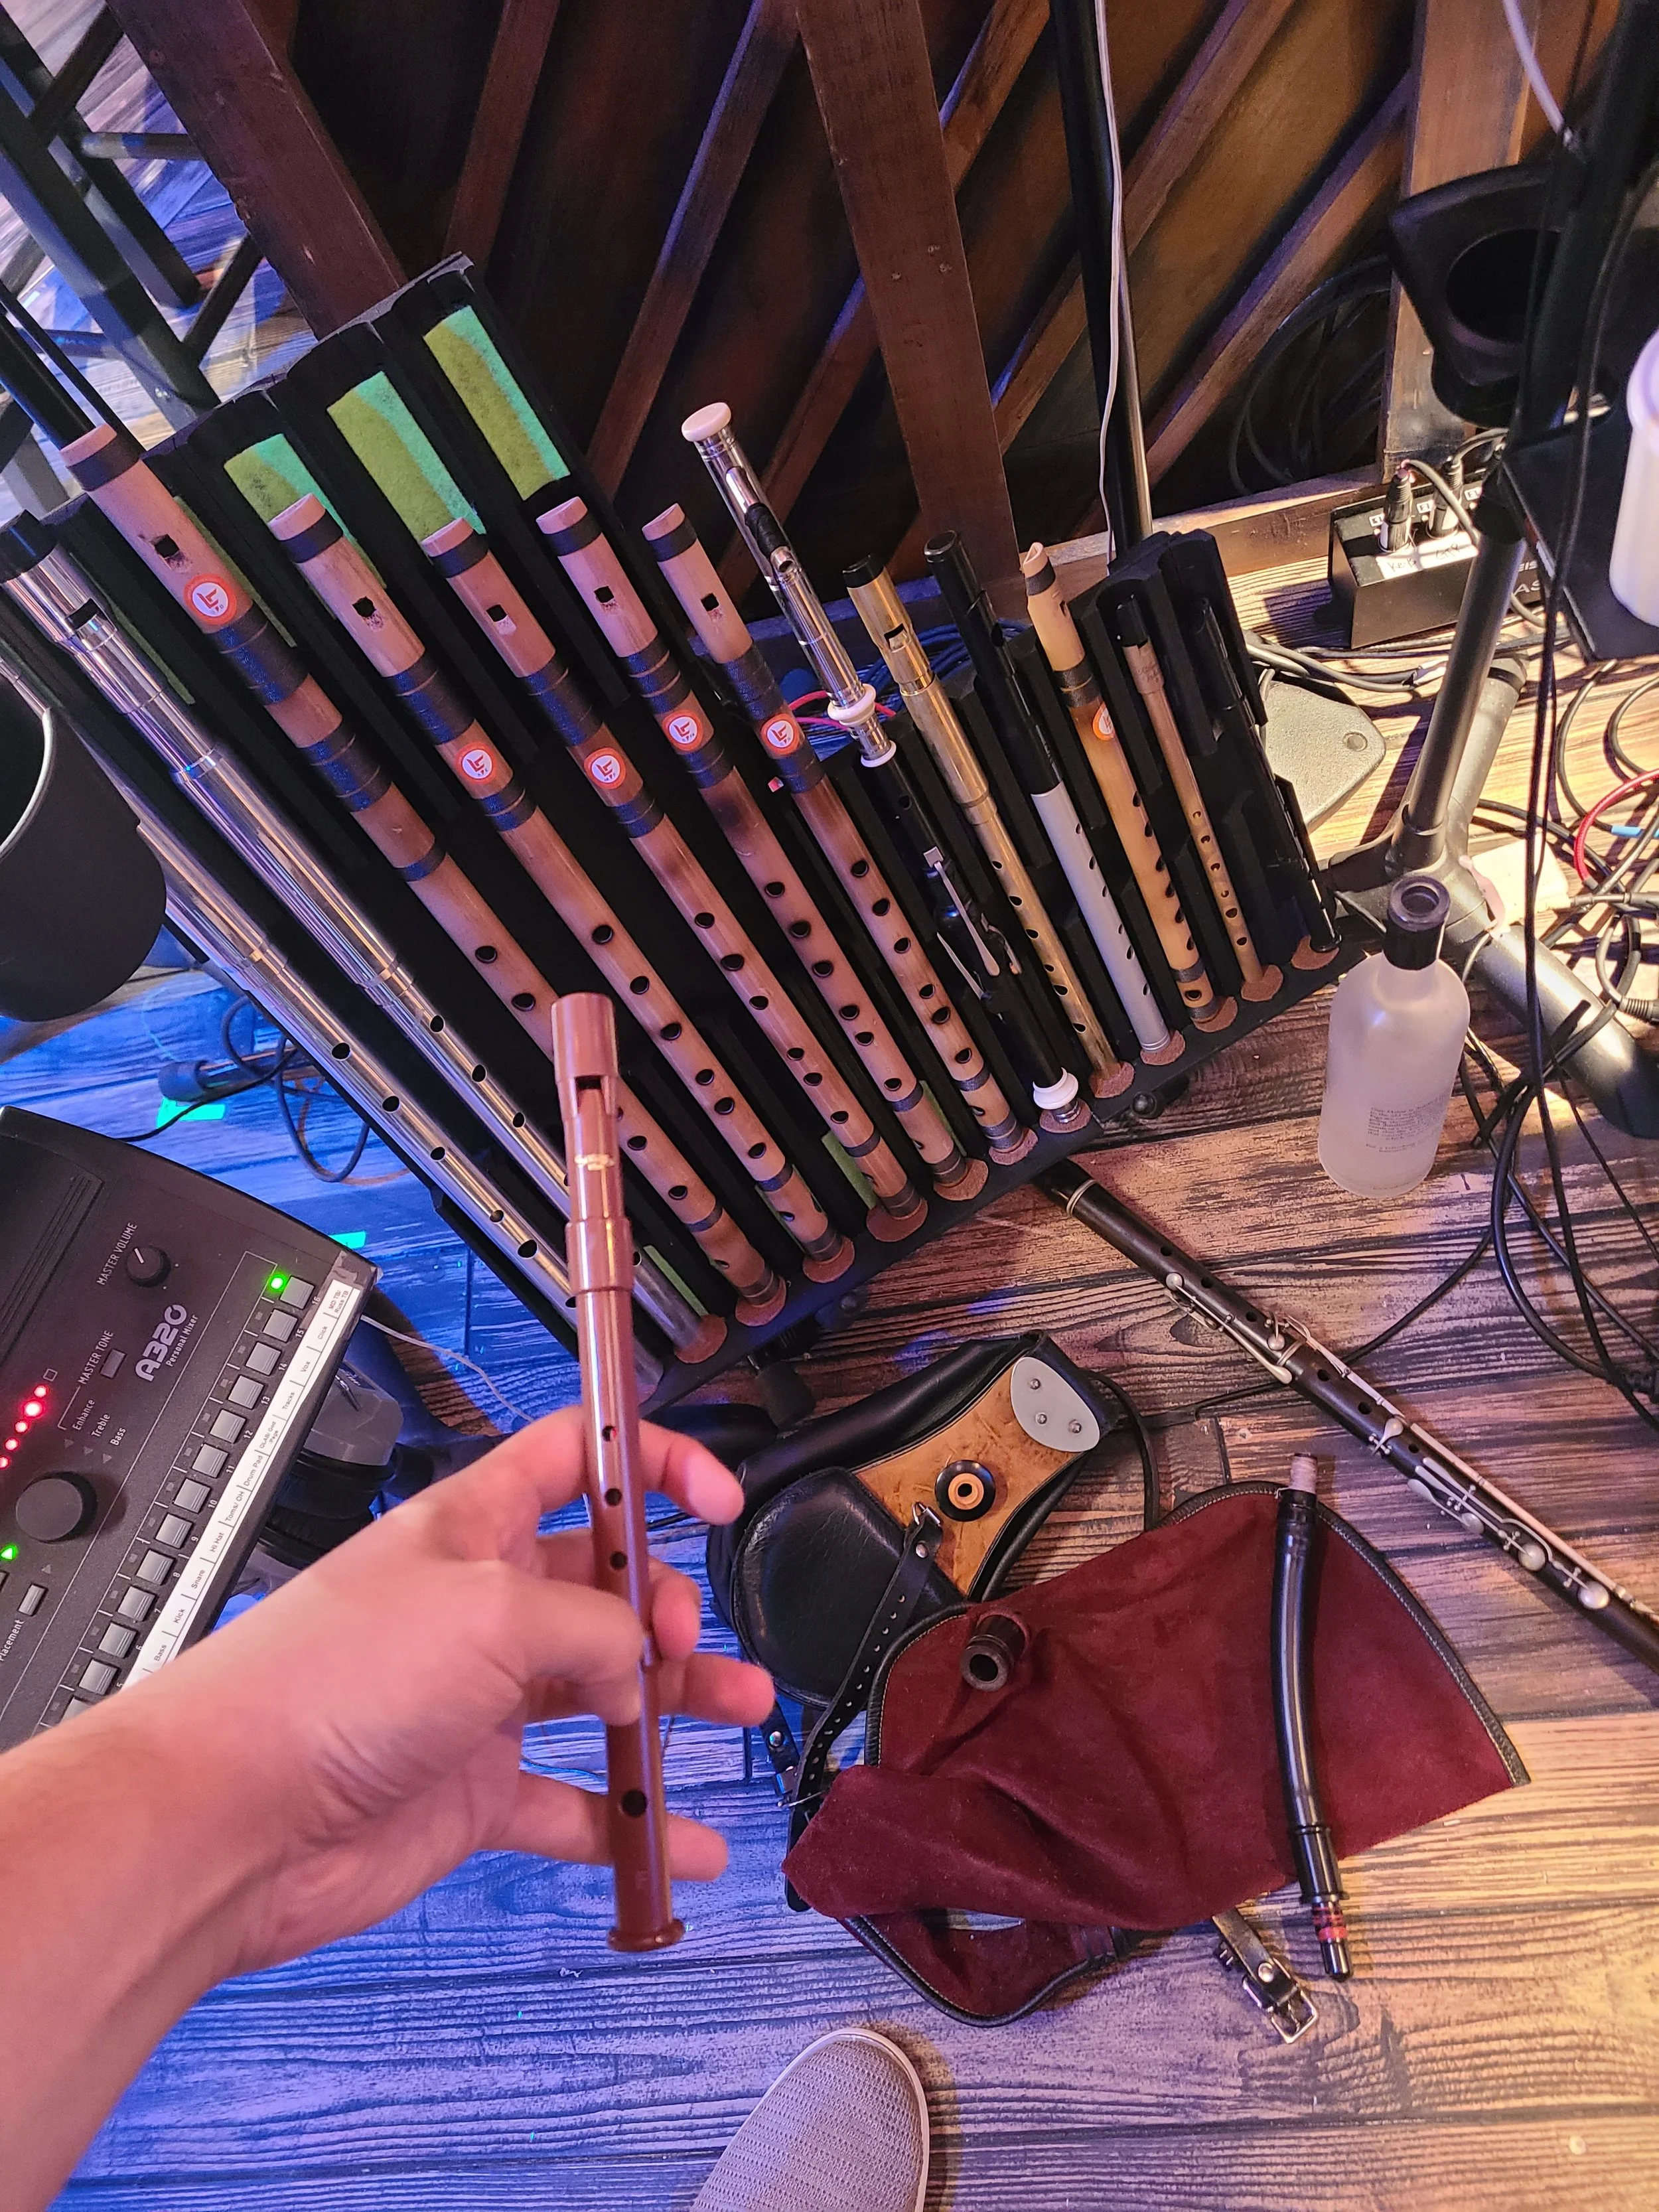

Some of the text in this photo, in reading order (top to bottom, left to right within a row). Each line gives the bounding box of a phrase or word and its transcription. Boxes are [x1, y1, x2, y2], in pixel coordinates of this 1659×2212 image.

[96, 1222, 138, 1286] MASTER VOLUME
[311, 1295, 321, 1305] 16
[165, 1314, 198, 1367] Personal Mixer
[295, 1329, 305, 1339] 15
[317, 1326, 328, 1340] Click
[135, 1304, 186, 1382] A320
[78, 1329, 114, 1385] MASTER TONE
[279, 1363, 288, 1372] 14
[300, 1361, 311, 1372] Vox
[261, 1396, 271, 1405] 13
[282, 1392, 295, 1410] Tracks
[72, 1398, 96, 1430] Enhance
[91, 1413, 110, 1438] Treble
[110, 1427, 126, 1446] Bass
[243, 1430, 253, 1439] 12
[226, 1465, 235, 1474] 11
[244, 1455, 263, 1487] Drum Pad
[208, 1499, 218, 1509] 10
[236, 1491, 245, 1502] OH
[214, 1532, 224, 1544] Hat
[191, 1569, 206, 1589] Snare
[173, 1608, 186, 1624] Kick
[154, 1644, 167, 1662] Bass
